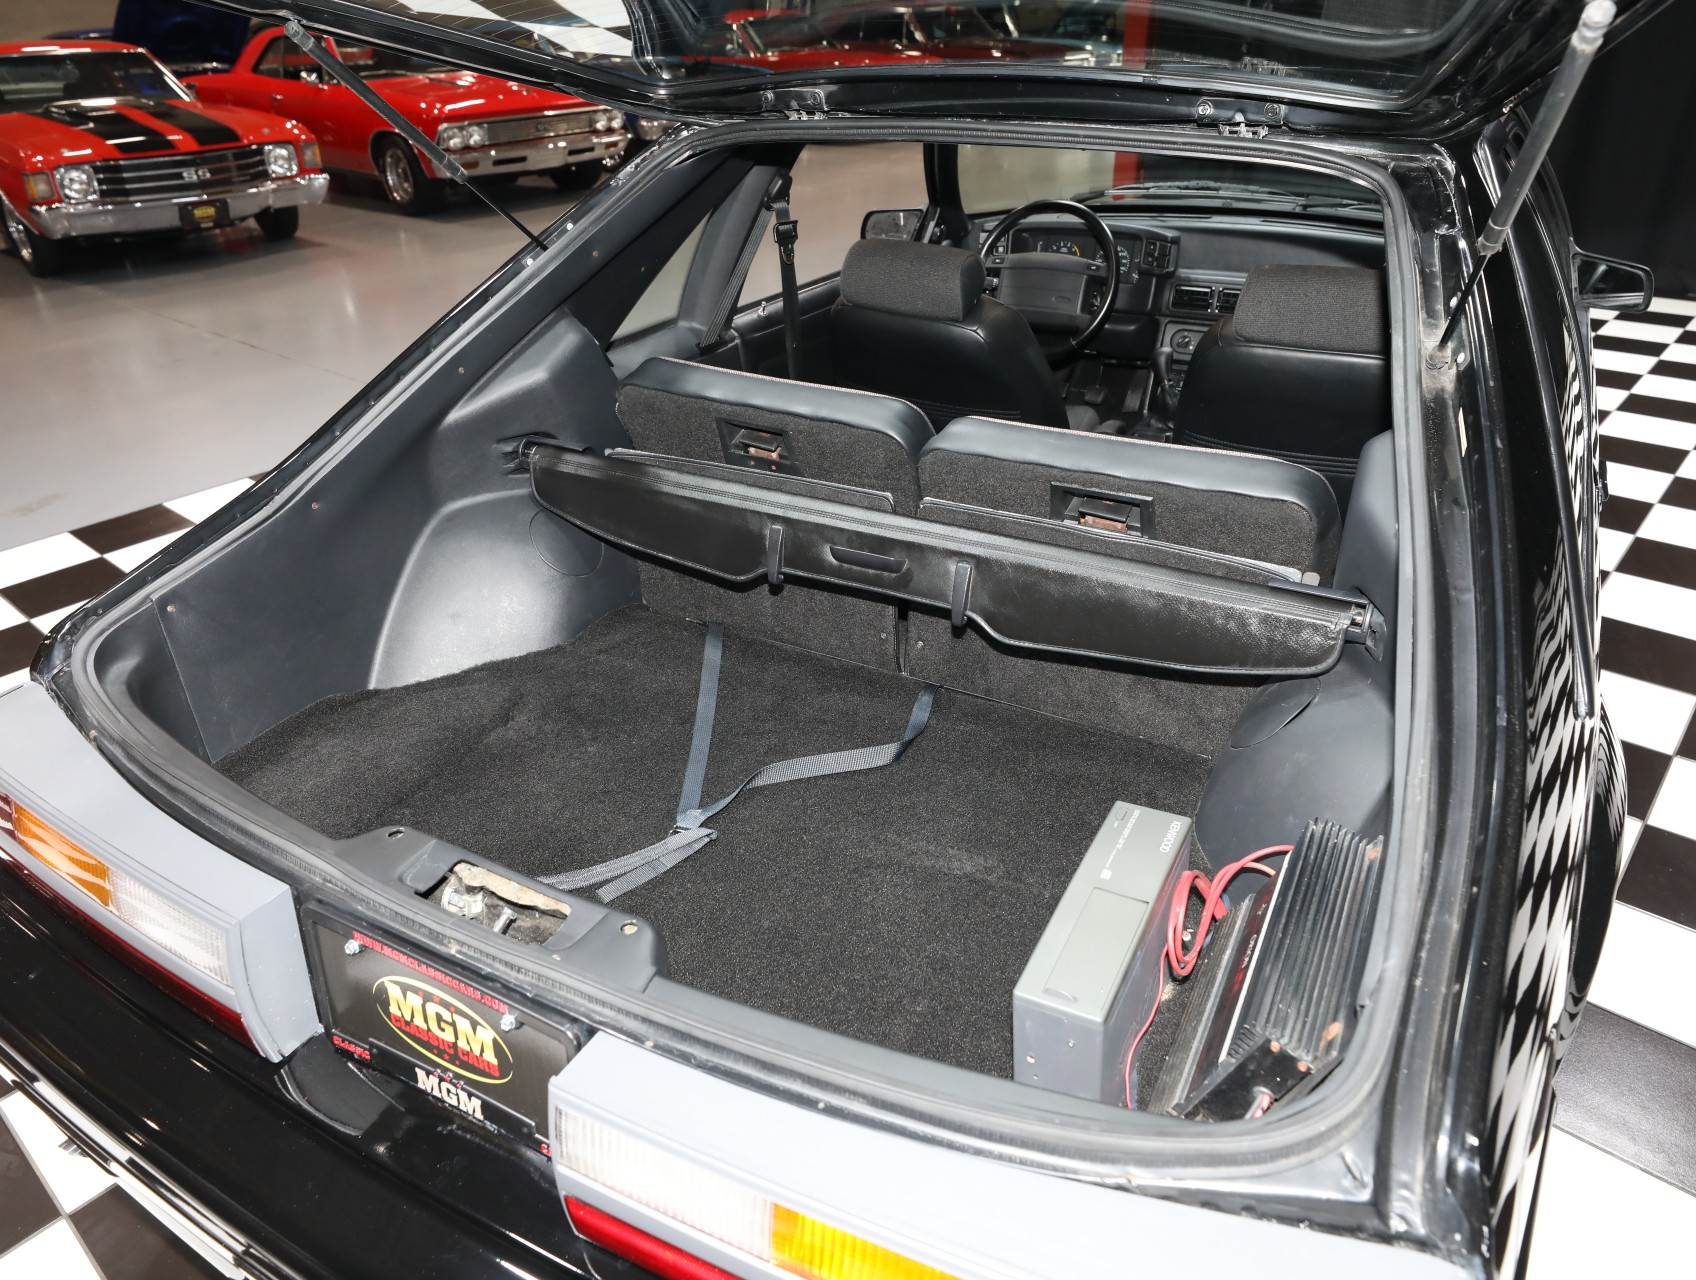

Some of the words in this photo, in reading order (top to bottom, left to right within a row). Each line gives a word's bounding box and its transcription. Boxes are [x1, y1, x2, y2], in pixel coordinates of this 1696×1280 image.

[182, 168, 211, 181] SS
[1159, 820, 1183, 853] KENWOOD
[384, 979, 499, 1066] MGM
[389, 1012, 455, 1055] CLASSIC
[457, 1045, 500, 1077] CARS
[414, 1066, 484, 1121] MGM
